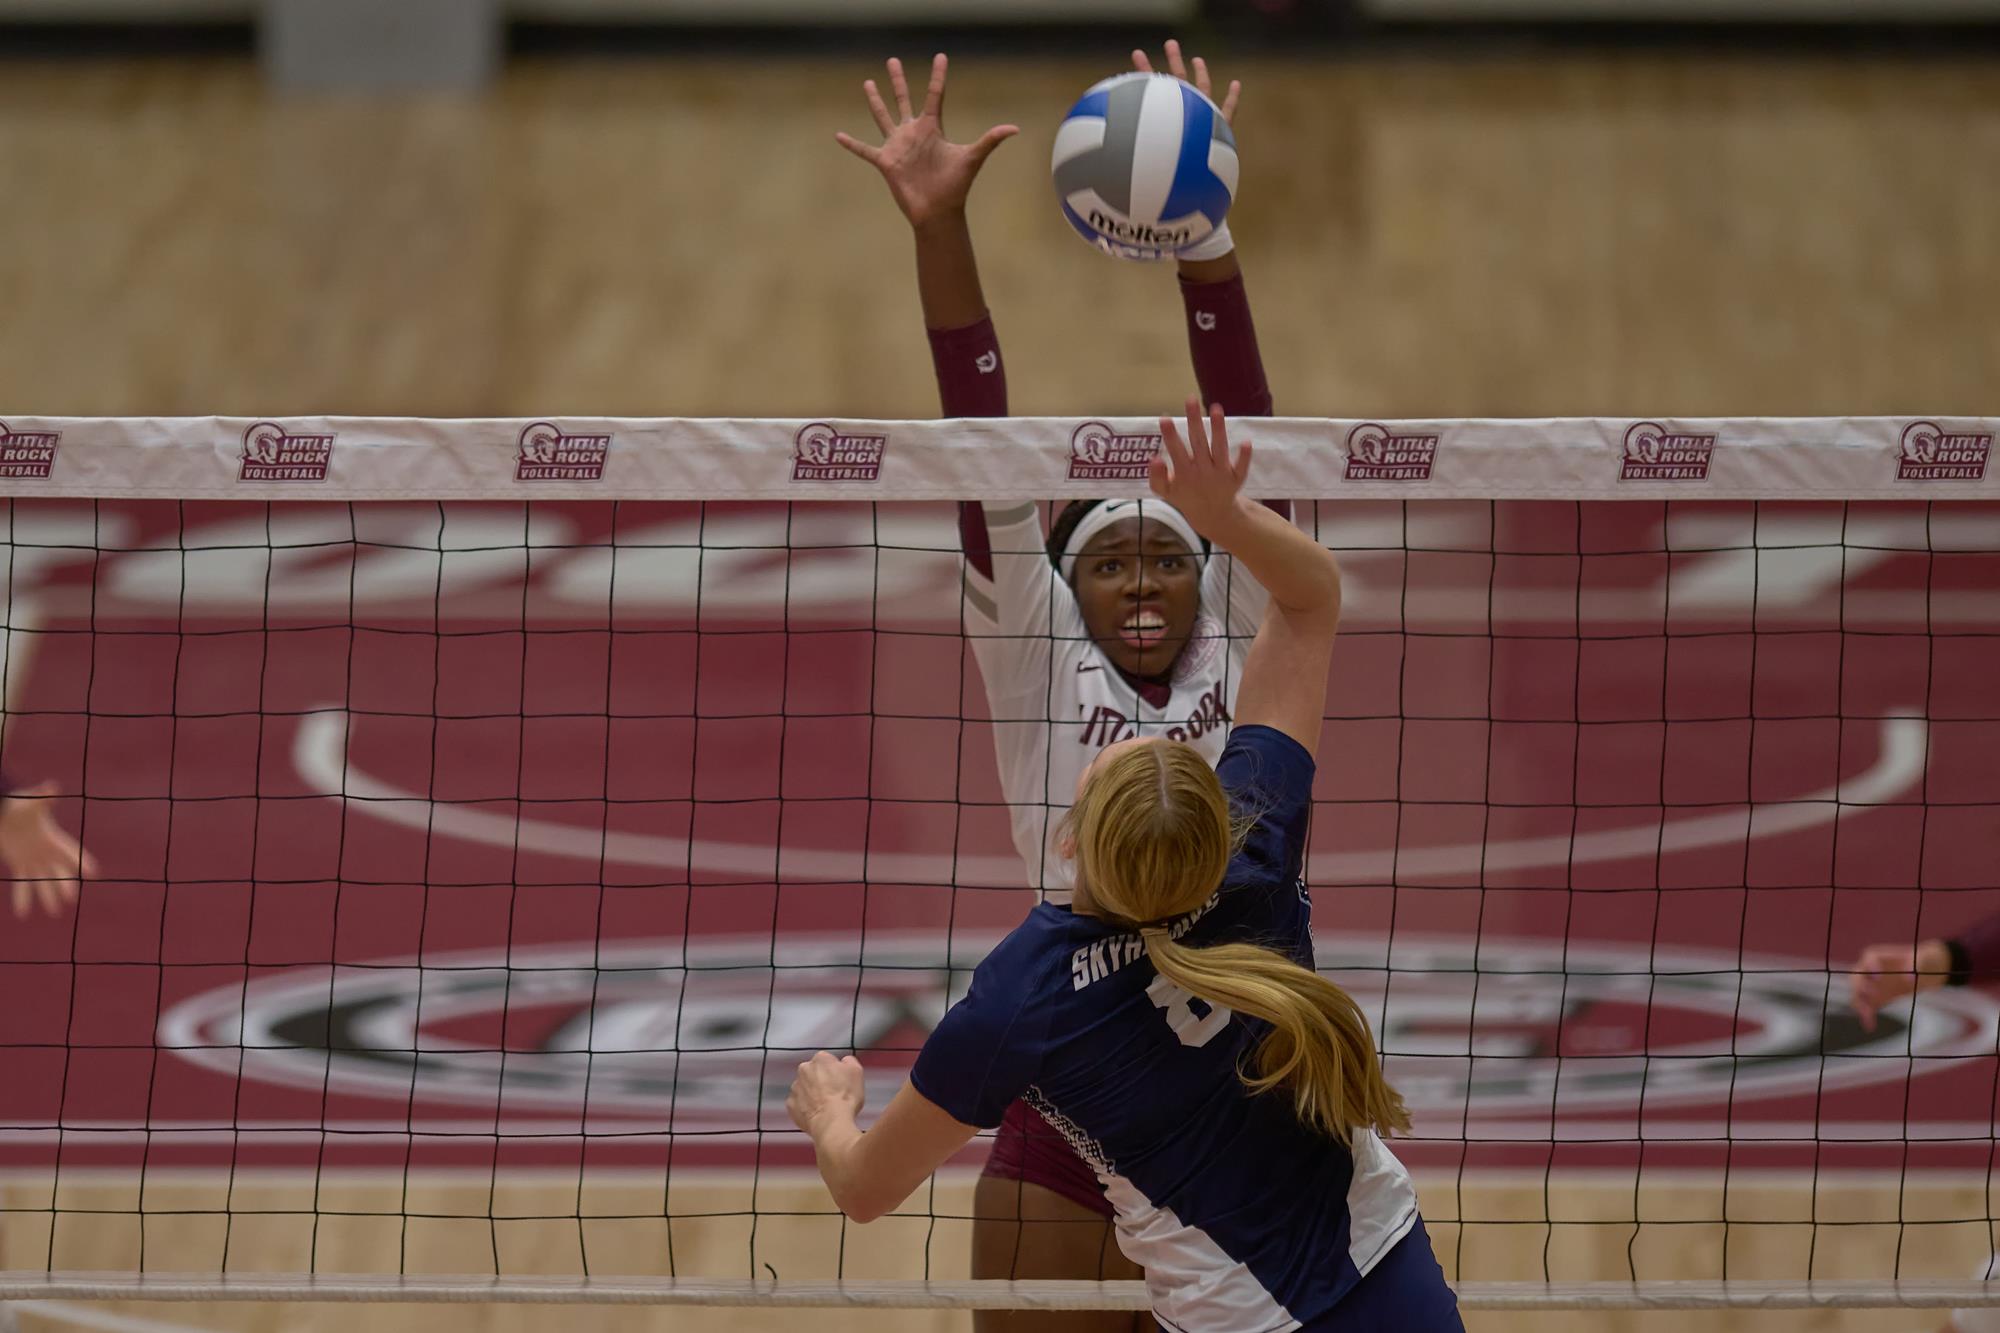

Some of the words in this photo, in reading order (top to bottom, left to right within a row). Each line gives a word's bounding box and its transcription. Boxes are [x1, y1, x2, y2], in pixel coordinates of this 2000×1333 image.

[1089, 209, 1191, 245] molten
[8, 435, 56, 448] LITTLE
[283, 438, 331, 451] LITTLE
[558, 438, 608, 450] LITTLE
[836, 438, 883, 450] LITTLE
[1111, 437, 1160, 449] LITTLE
[1388, 438, 1436, 450] LITTLE
[1664, 437, 1713, 450] LITTLE
[1941, 437, 1989, 449] LITTLE
[3, 449, 52, 460] ROCK
[279, 451, 328, 463] ROCK
[555, 451, 604, 463] ROCK
[831, 451, 880, 463] ROCK
[1107, 451, 1155, 462] ROCK
[1384, 451, 1432, 463] ROCK
[1660, 451, 1709, 462] ROCK
[1937, 450, 1985, 462] ROCK
[245, 468, 321, 478] VOLLEYBALL
[521, 468, 598, 478] VOLLEYBALL
[797, 468, 875, 479] VOLLEYBALL
[1349, 468, 1426, 478] VOLLEYBALL
[1625, 468, 1702, 478] VOLLEYBALL
[1902, 468, 1980, 478] VOLLEYBALL
